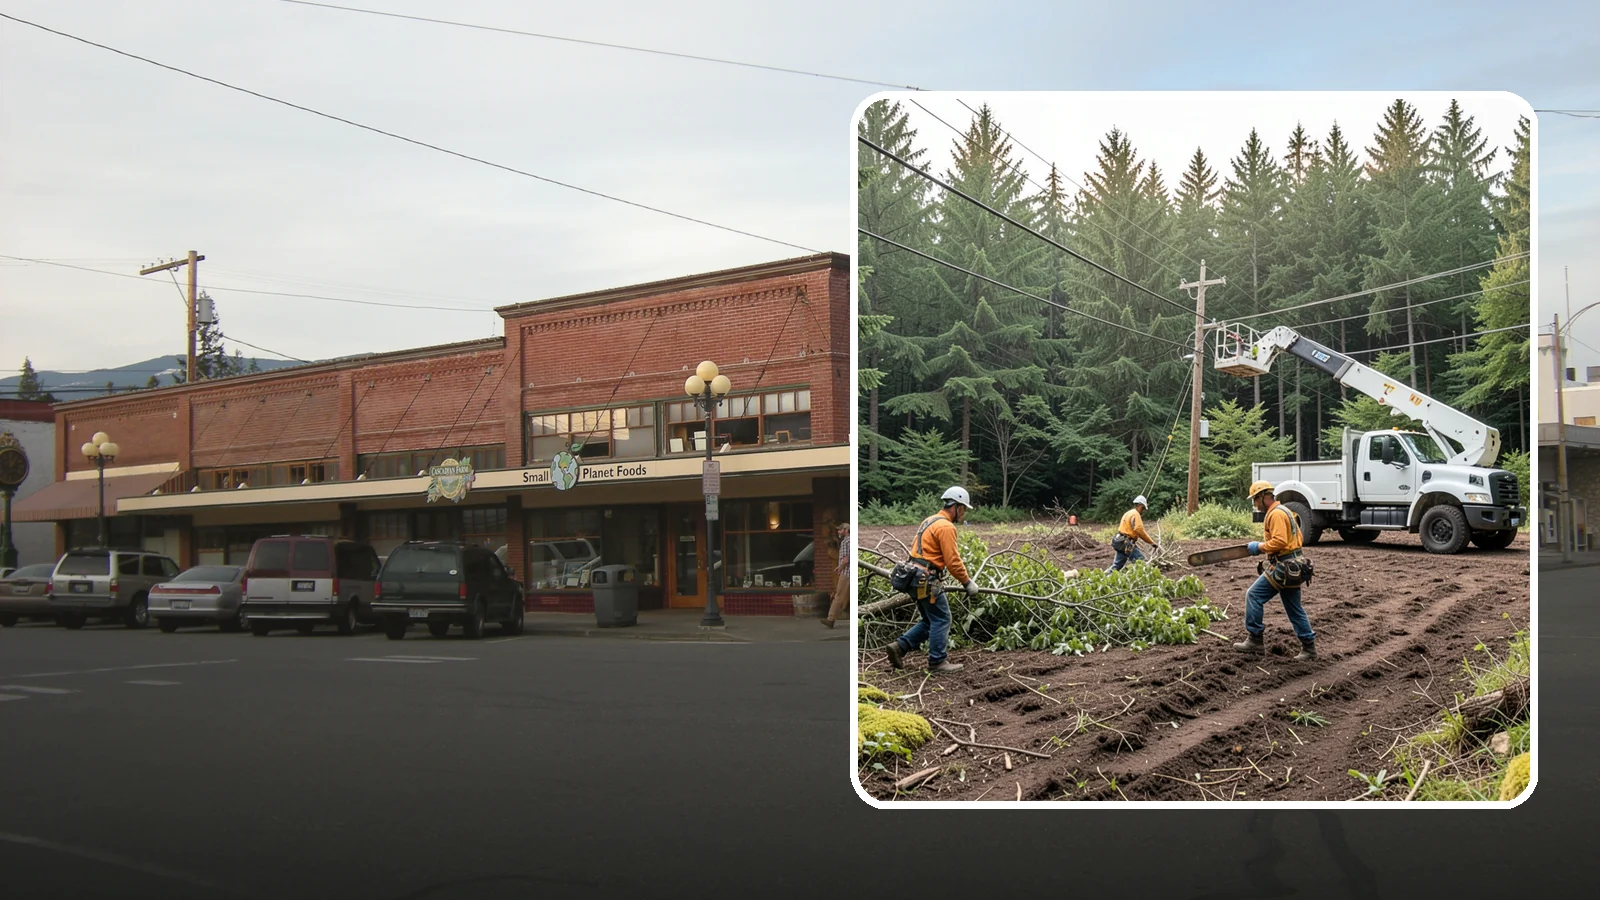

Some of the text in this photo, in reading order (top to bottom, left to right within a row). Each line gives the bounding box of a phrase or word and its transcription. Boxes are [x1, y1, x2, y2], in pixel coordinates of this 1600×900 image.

[523, 464, 647, 483] Small Planet Foods
